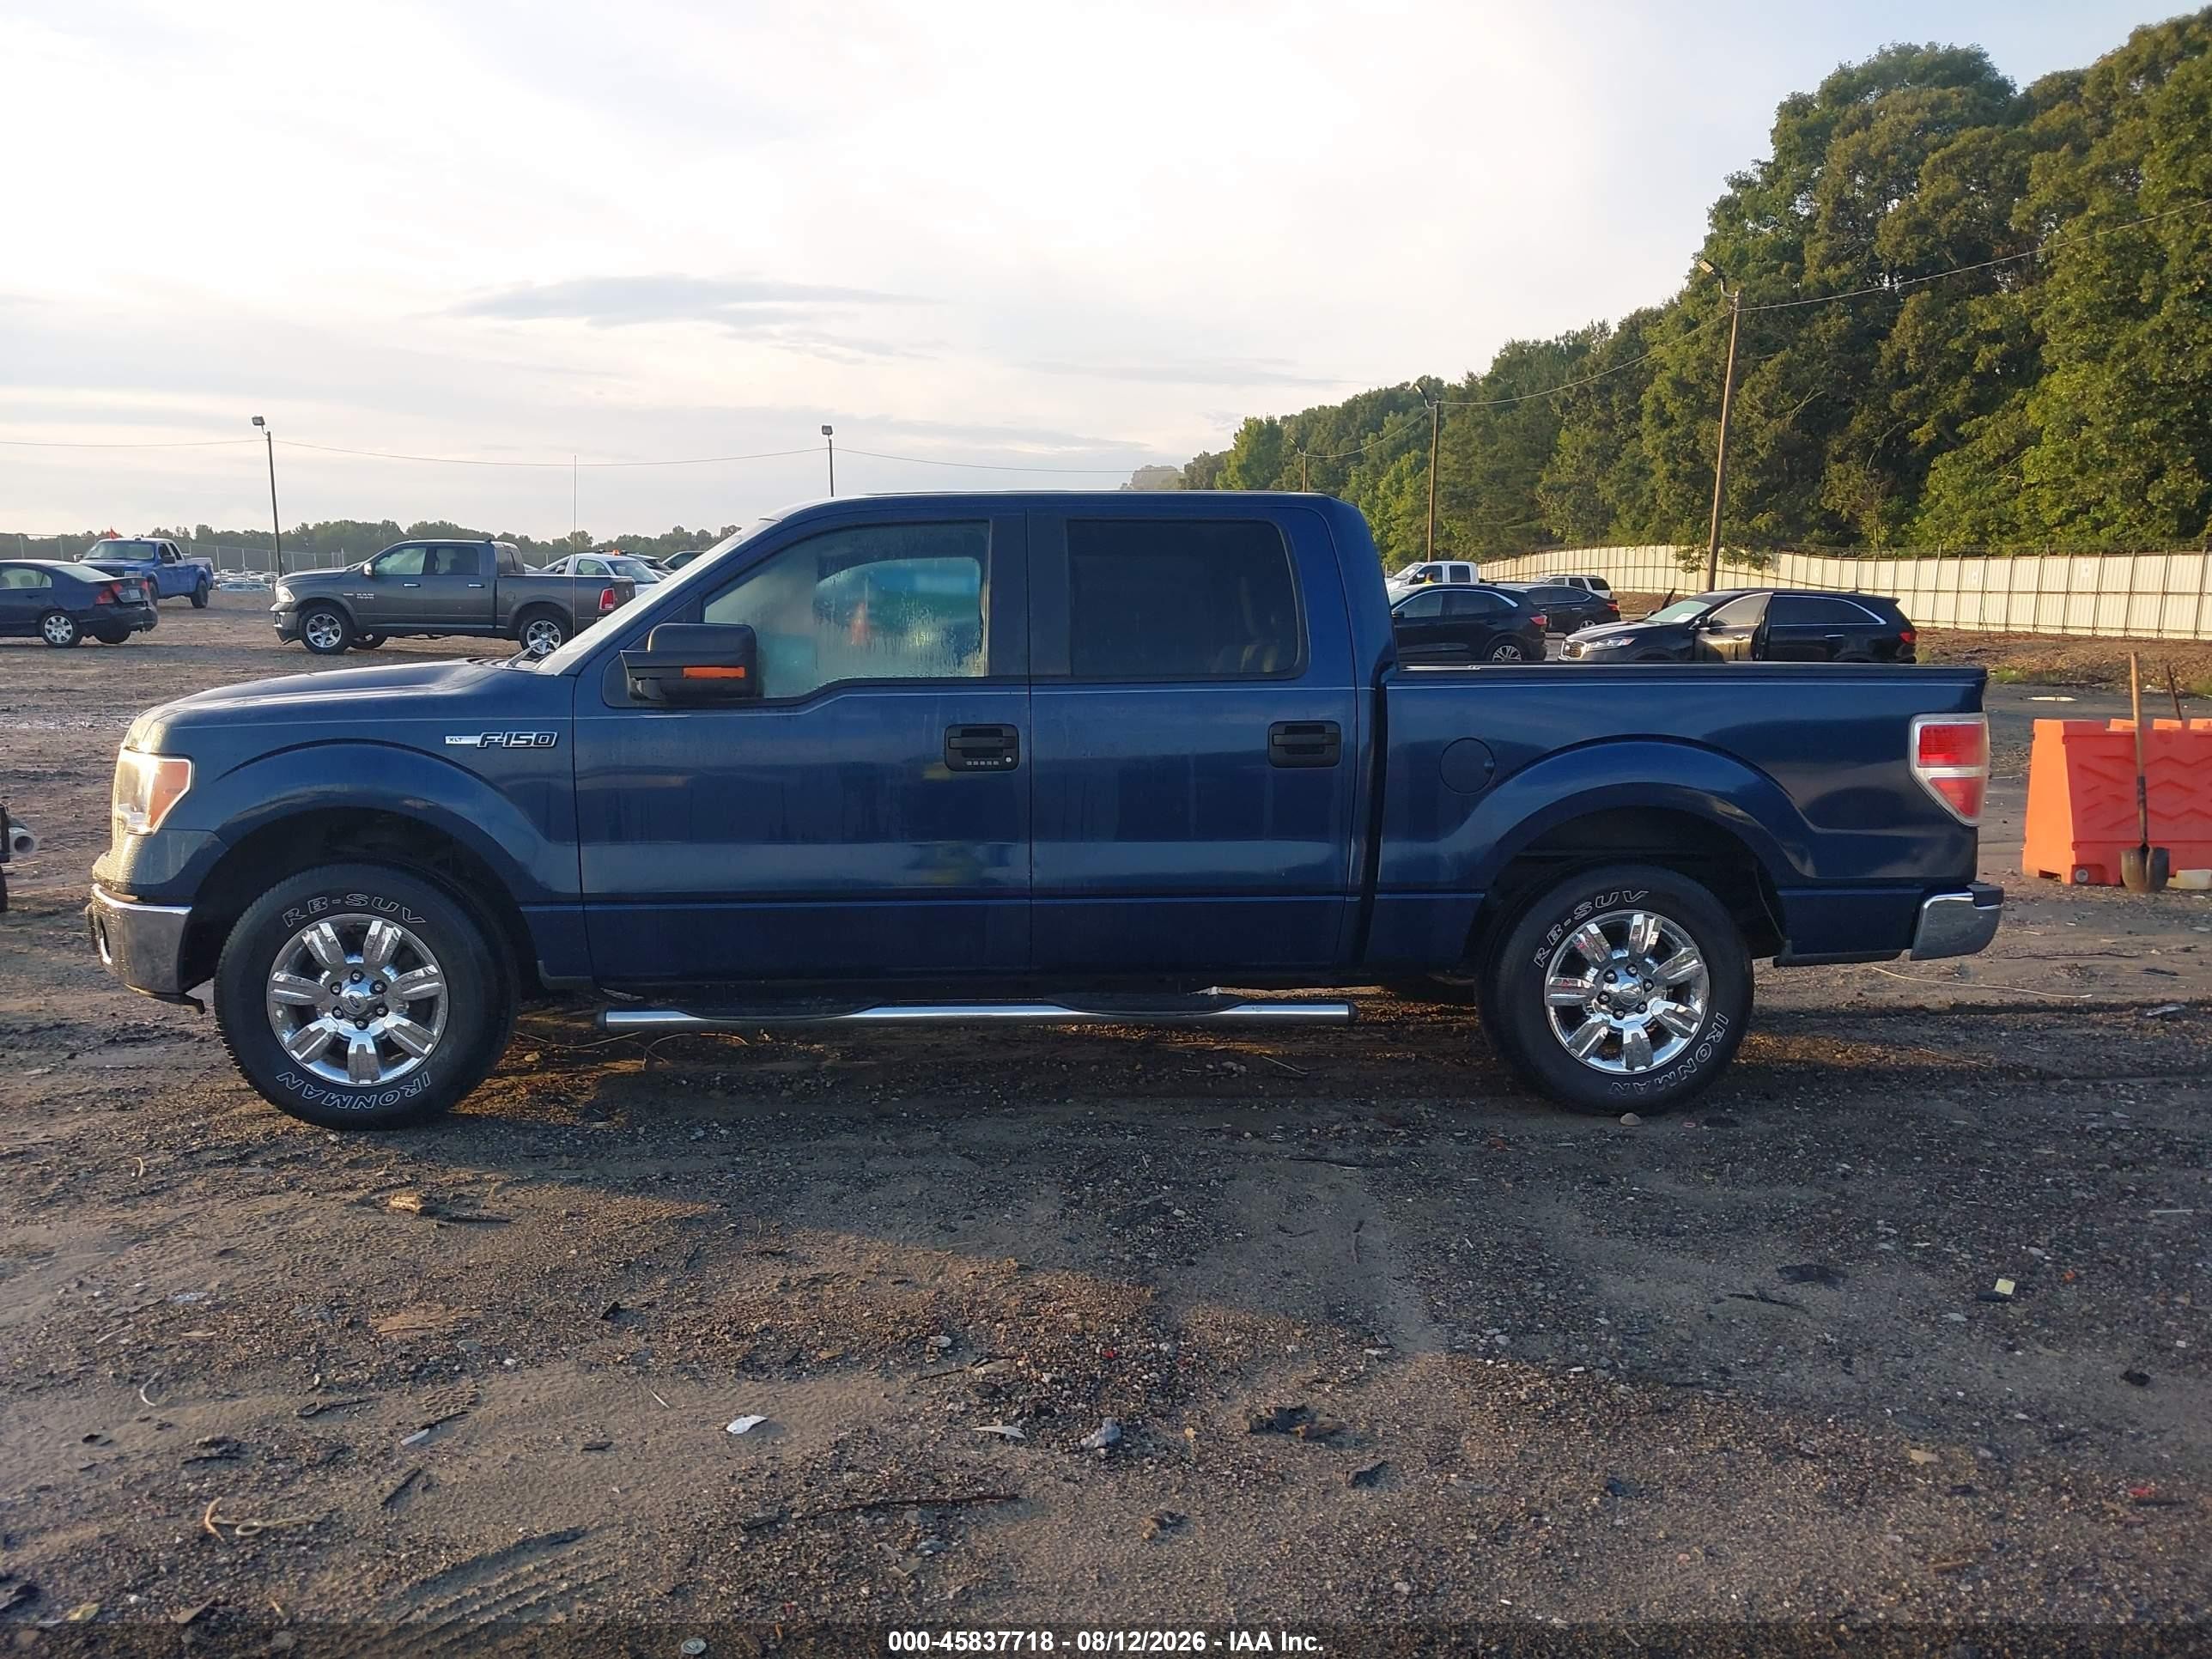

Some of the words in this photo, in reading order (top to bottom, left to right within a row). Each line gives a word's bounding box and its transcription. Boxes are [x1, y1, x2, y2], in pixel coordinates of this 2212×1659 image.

[282, 893, 427, 928] RB-SUV
[1534, 890, 1650, 969] RB-SUV
[1607, 1012, 1729, 1097] IRONMAN
[276, 1071, 431, 1109] IRONMAN
